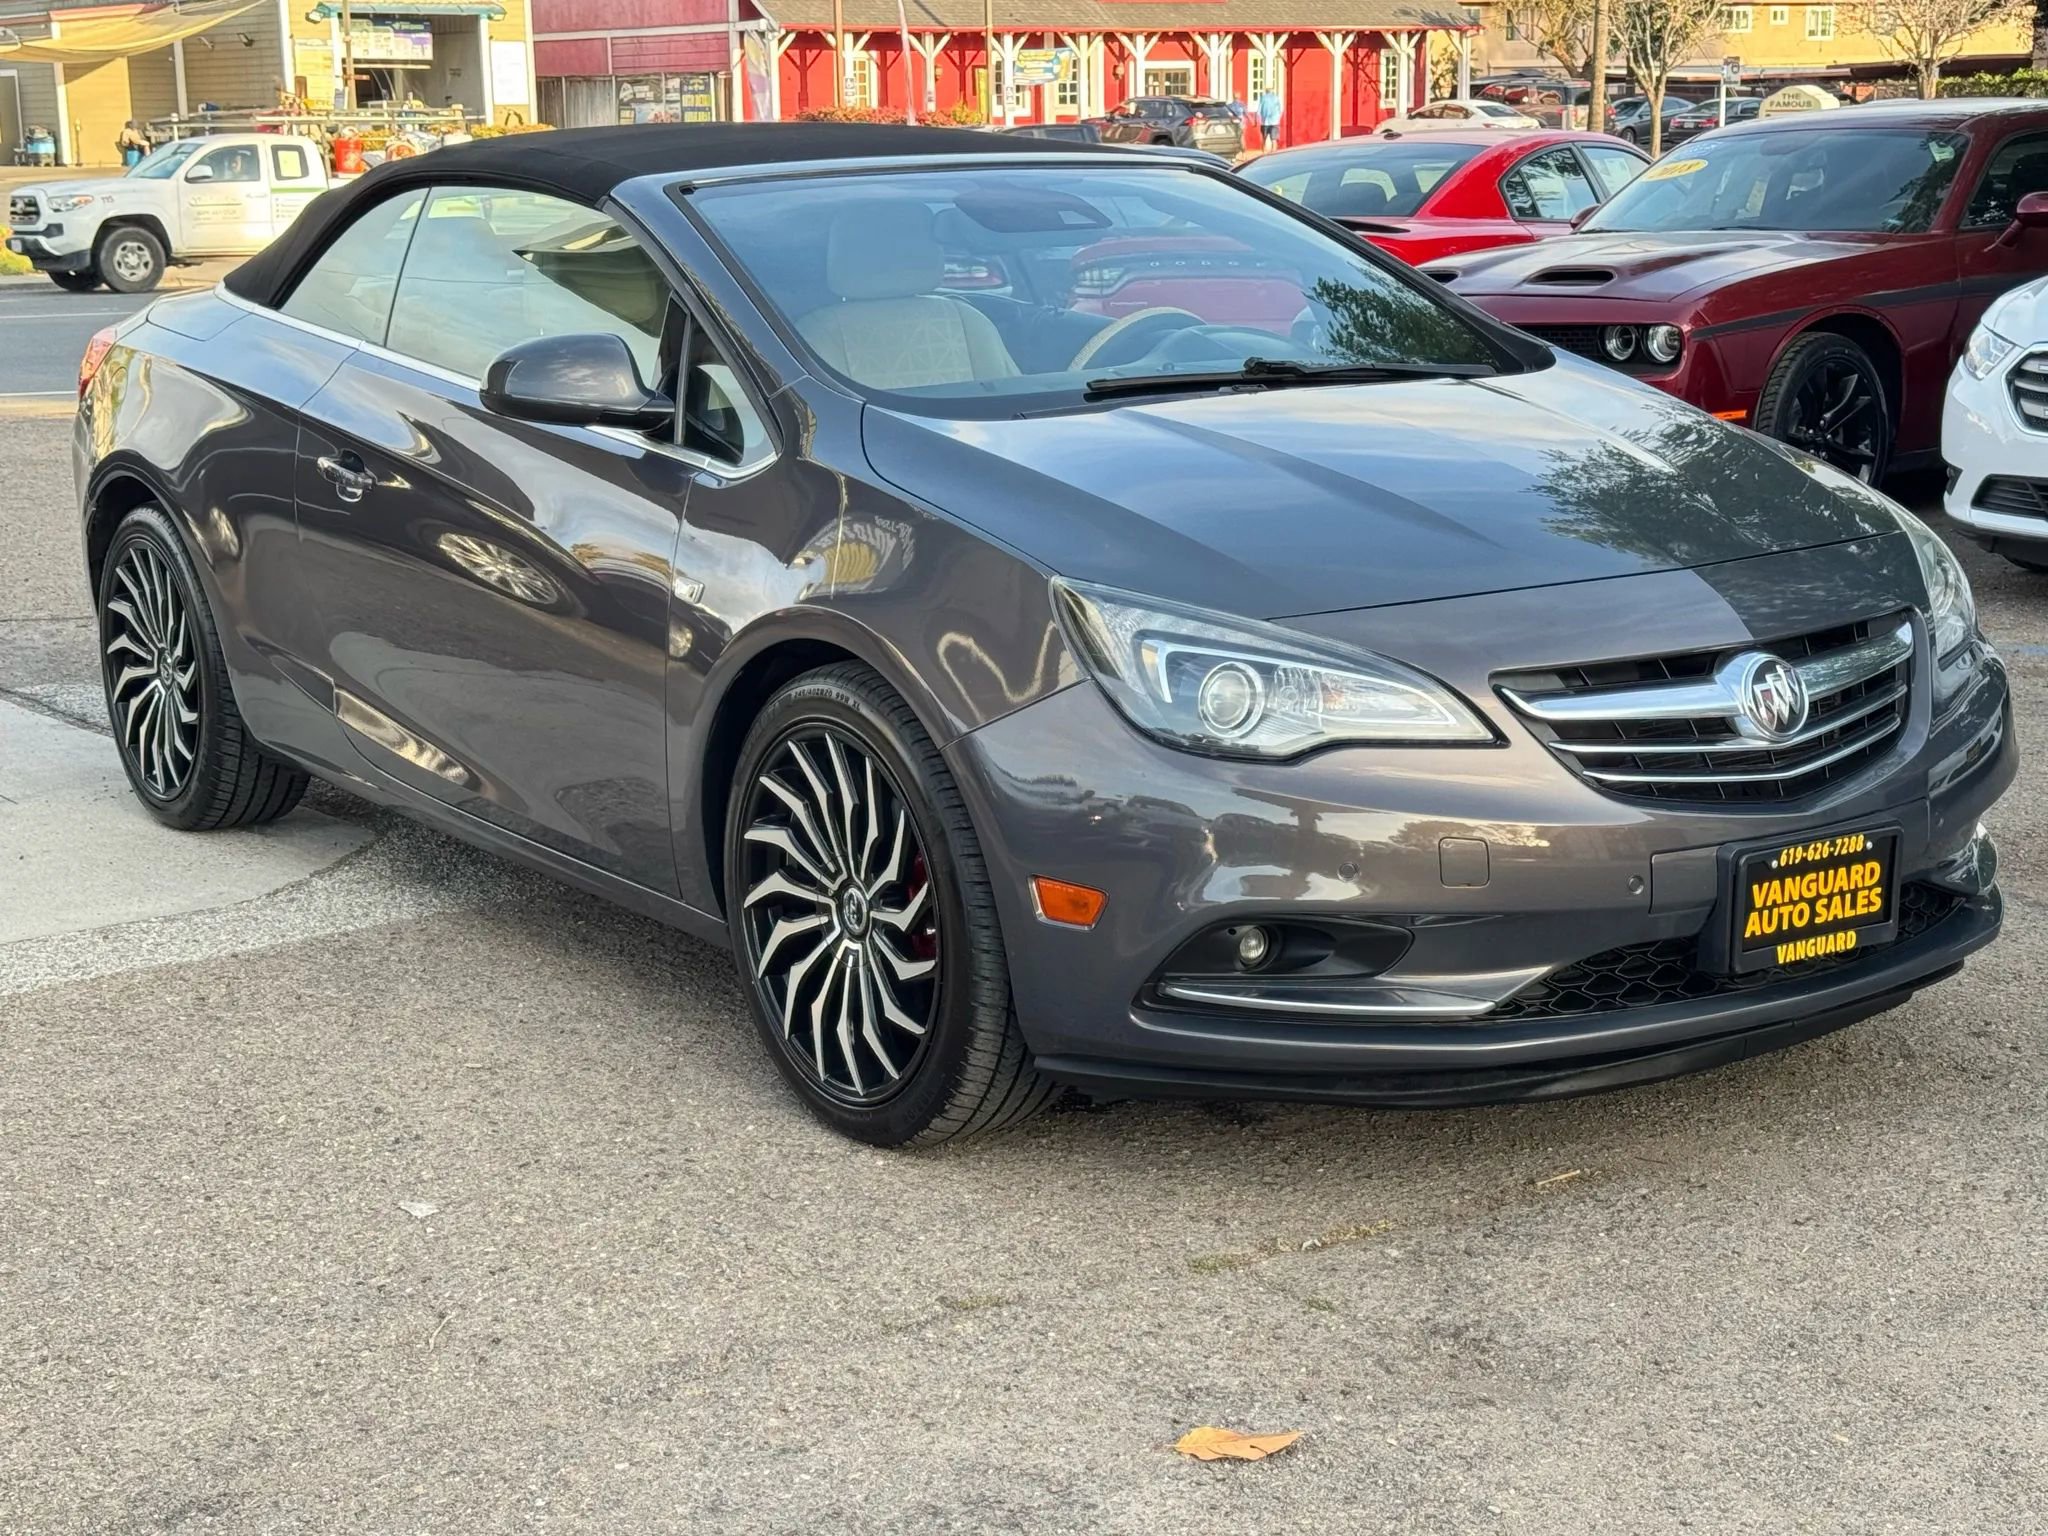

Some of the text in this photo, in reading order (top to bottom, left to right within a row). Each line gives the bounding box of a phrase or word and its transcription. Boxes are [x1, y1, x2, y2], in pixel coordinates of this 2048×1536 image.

[1769, 100, 1813, 108] FAMOUS
[1782, 92, 1800, 100] THE
[1780, 834, 1865, 867] 619-626-7288
[1752, 861, 1881, 909] VANGUARD
[1744, 887, 1882, 938] AUTO SALES
[1776, 930, 1857, 965] VANGUARD
